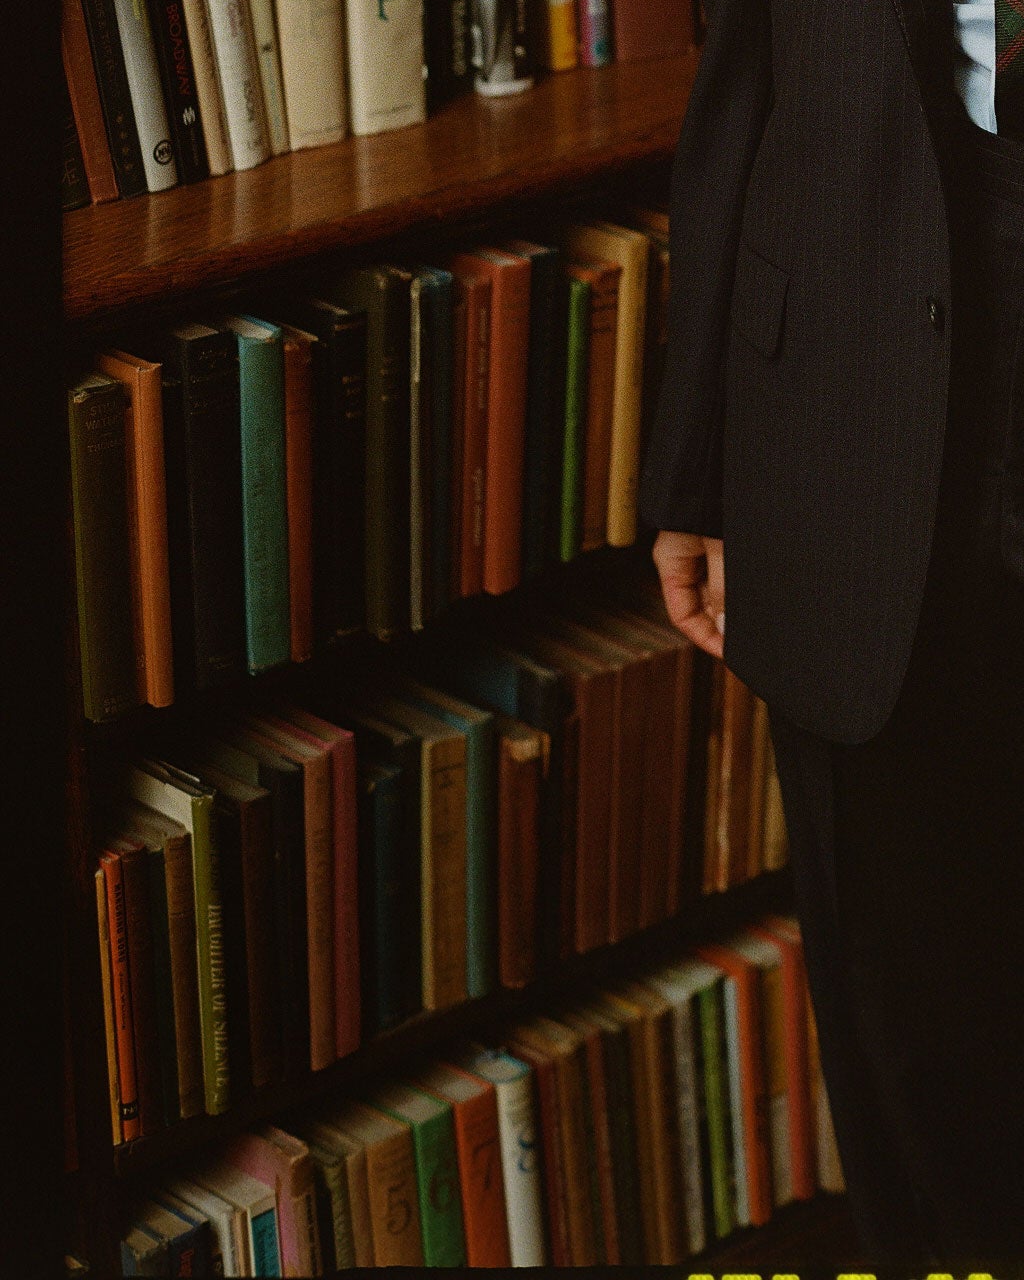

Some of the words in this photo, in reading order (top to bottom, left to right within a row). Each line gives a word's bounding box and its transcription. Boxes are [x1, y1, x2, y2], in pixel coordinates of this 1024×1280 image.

[166, 2, 192, 96] BROADWAY
[114, 883, 126, 934] MARCHING
[117, 936, 127, 963] SONG
[208, 904, 226, 988] DAUGHTER
[212, 993, 228, 1012] OF
[213, 1019, 230, 1087] SILENCE
[386, 1179, 412, 1235] 5
